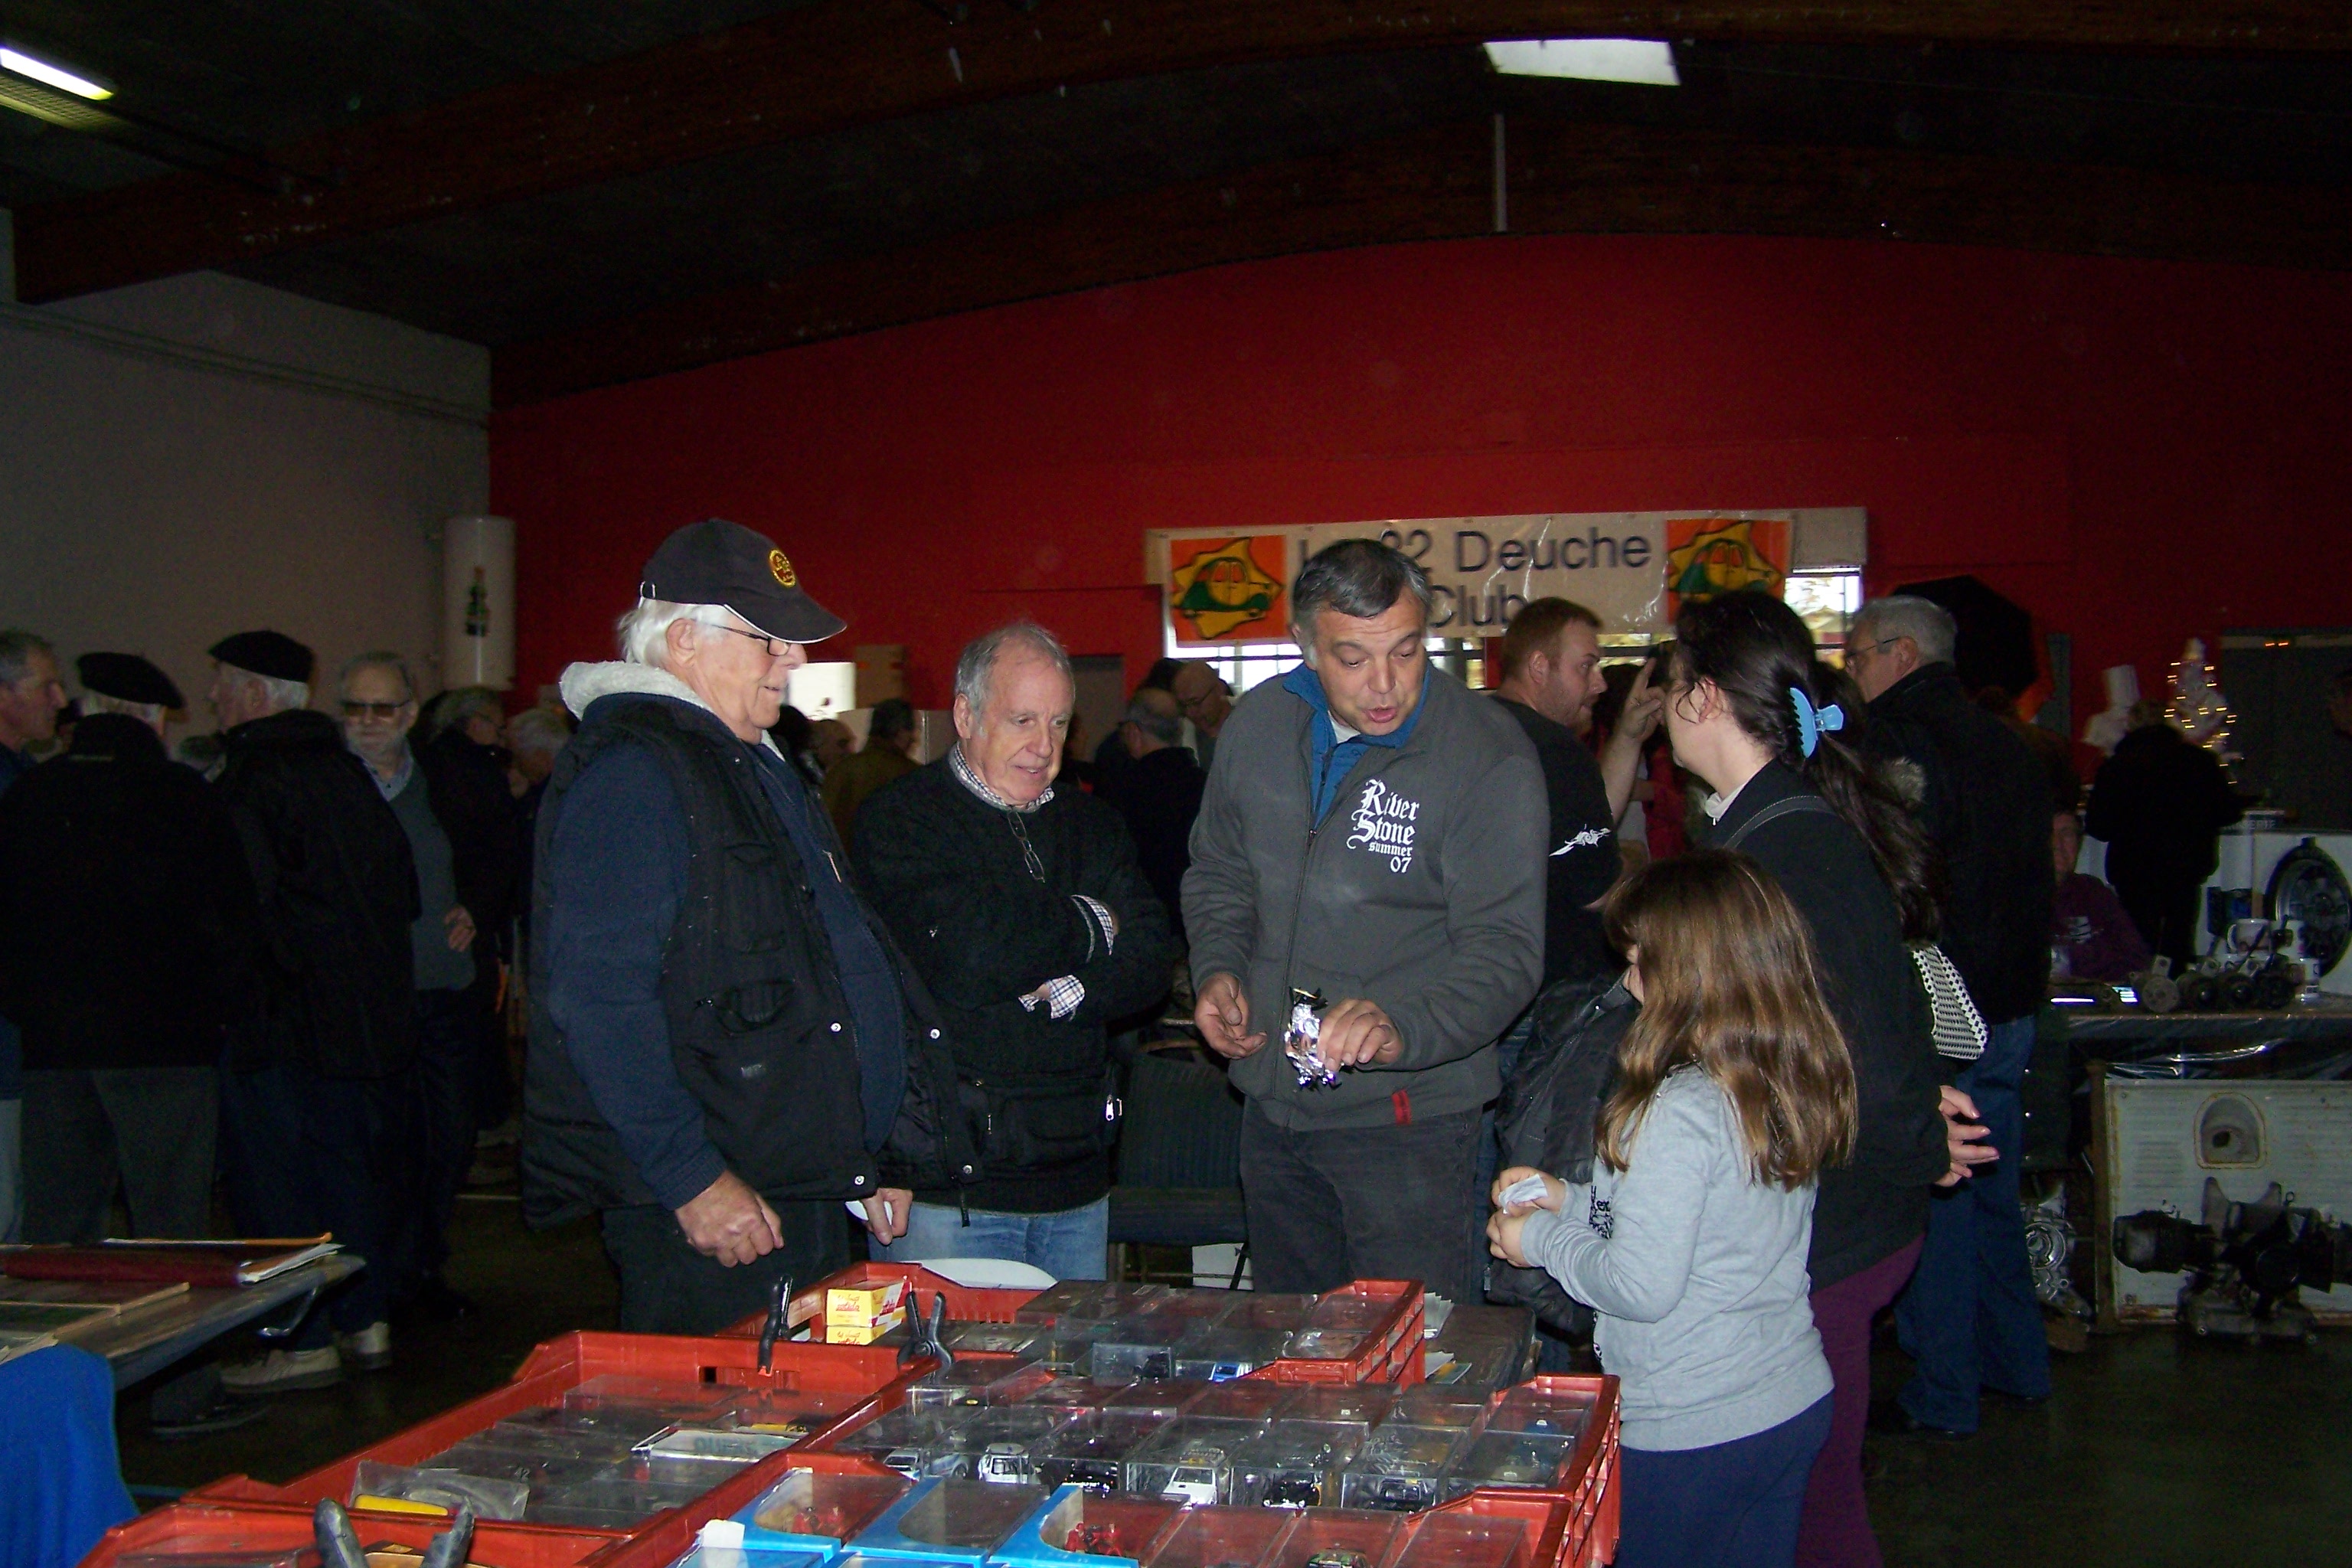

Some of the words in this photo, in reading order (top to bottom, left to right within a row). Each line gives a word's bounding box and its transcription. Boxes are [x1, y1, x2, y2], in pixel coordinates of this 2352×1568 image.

[1457, 527, 1651, 572] Deuche
[1429, 584, 1530, 629] Club
[1360, 779, 1420, 822] River
[1346, 808, 1416, 849] Stone
[1368, 841, 1413, 857] summer
[1390, 856, 1413, 873] 07
